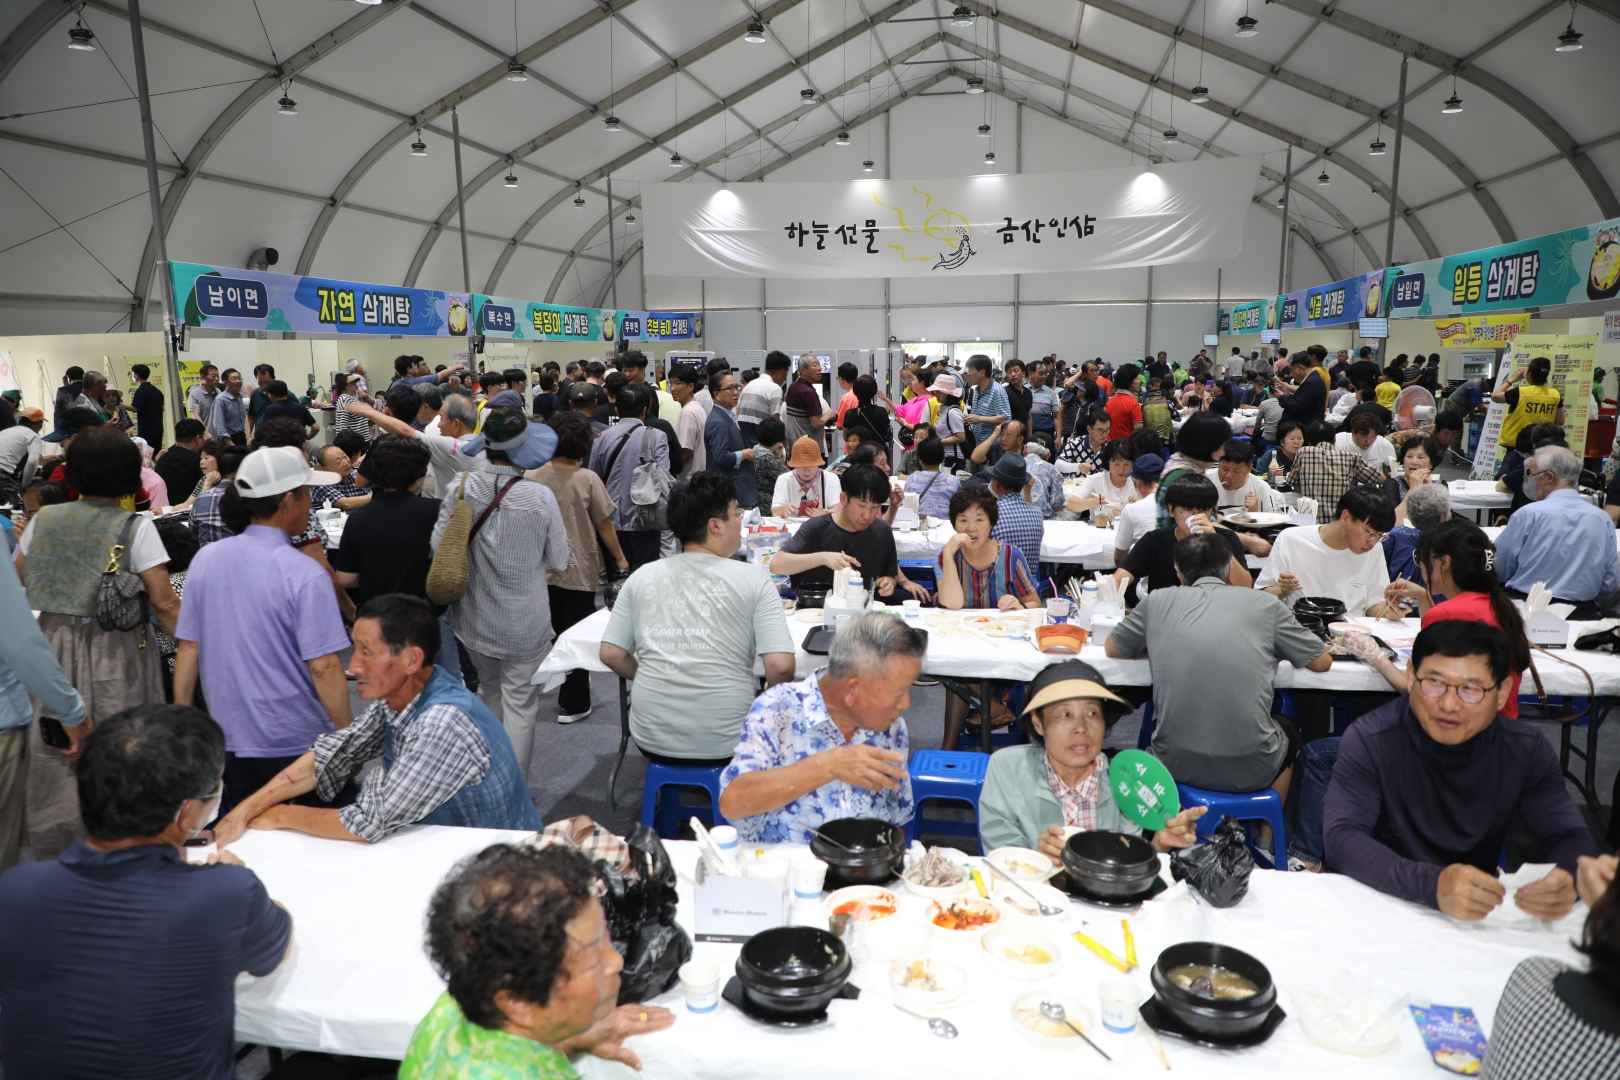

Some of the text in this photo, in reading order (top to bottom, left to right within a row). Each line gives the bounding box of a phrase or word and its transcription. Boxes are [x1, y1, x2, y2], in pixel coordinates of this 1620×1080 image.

[996, 213, 1097, 245] 금산인삼
[1397, 280, 1421, 301] 남일면
[1453, 253, 1540, 303] 일등 삼계탕
[207, 284, 259, 311] 남이면
[318, 288, 411, 326] 자연 삼계탕
[1324, 288, 1345, 317] 삼계탕
[487, 309, 512, 328] 복수면
[533, 310, 589, 336] 복덩이 삼계탕
[672, 319, 689, 335] 삼계탕
[1525, 402, 1557, 415] STAFF
